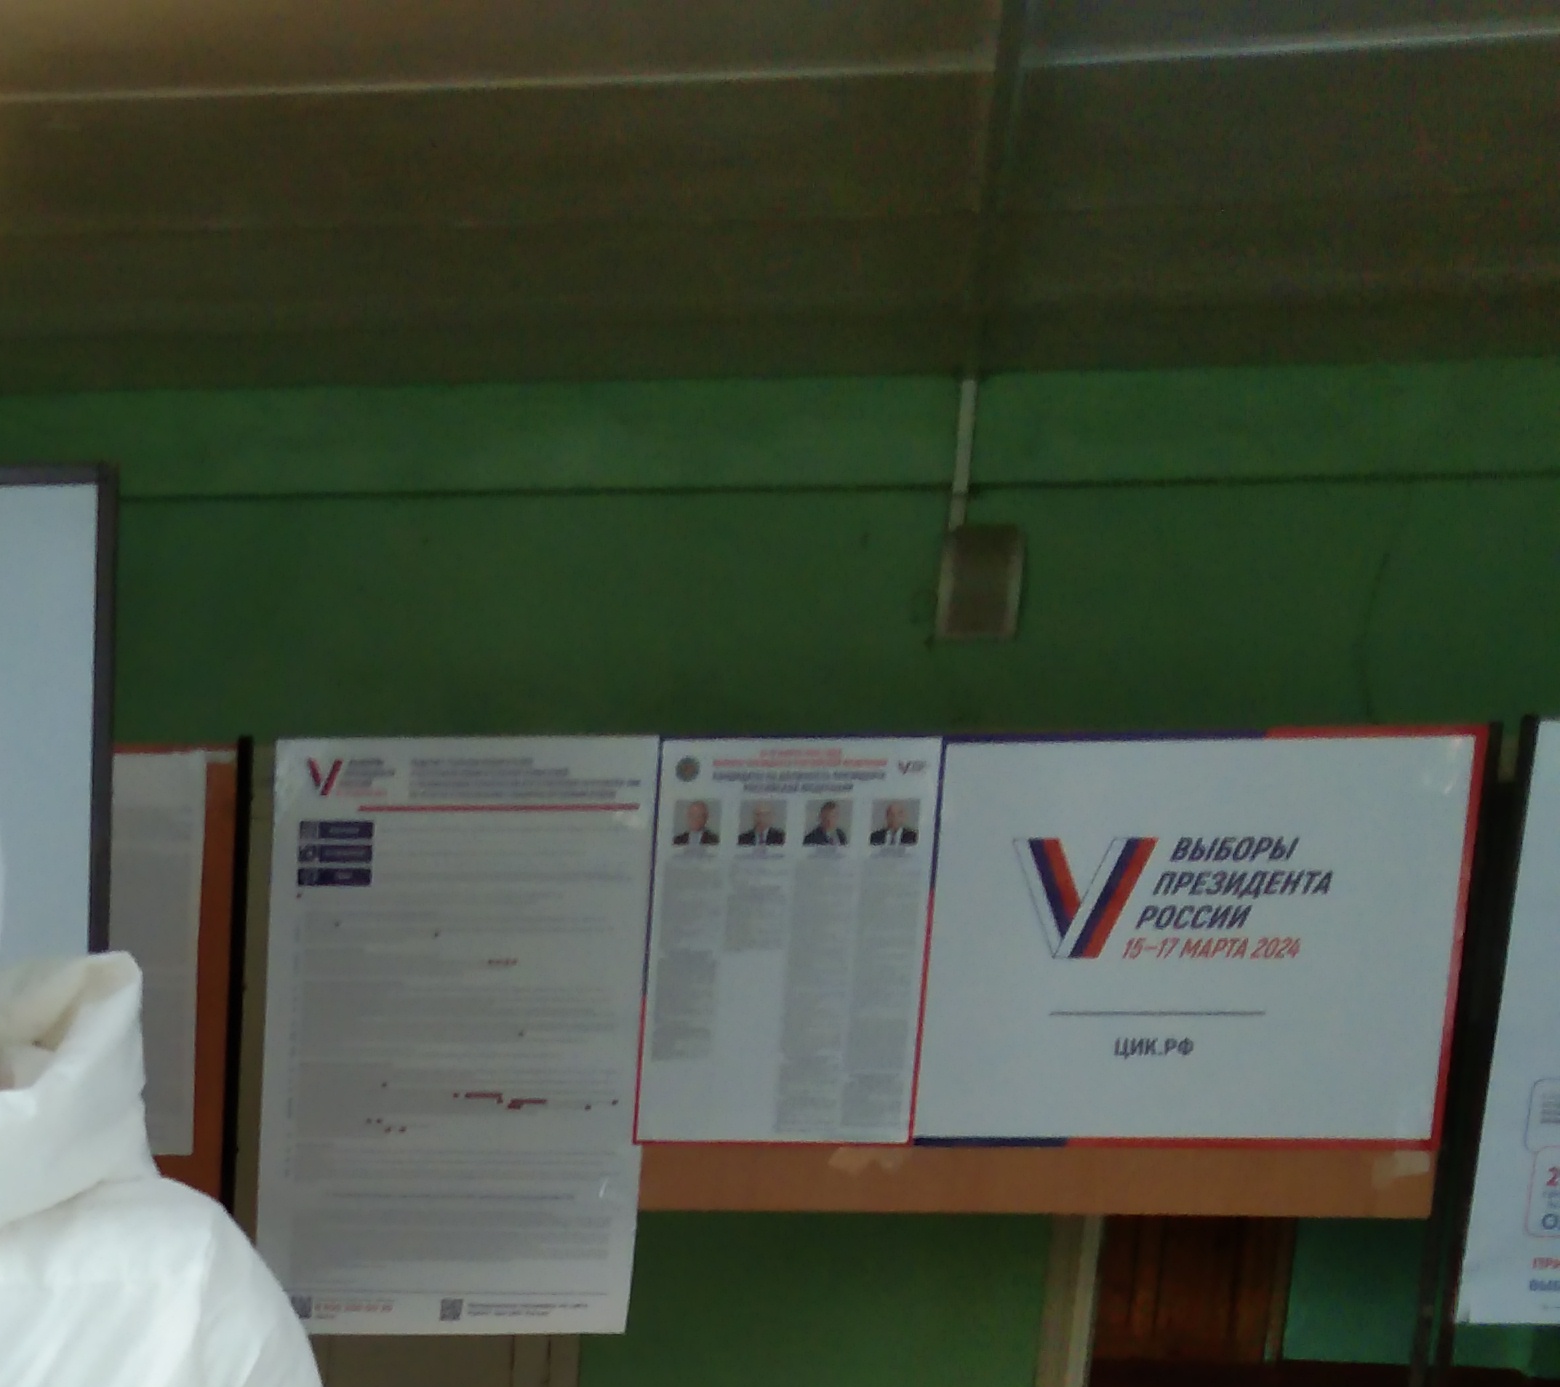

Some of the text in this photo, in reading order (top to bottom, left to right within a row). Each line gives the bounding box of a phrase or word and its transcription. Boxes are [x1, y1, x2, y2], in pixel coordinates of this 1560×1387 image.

[1170, 836, 1300, 862] ВЫБОРЫ
[1152, 870, 1334, 899] ПРЕЗИДЕНТА
[1135, 904, 1252, 930] РОССИИ
[1178, 937, 1250, 959] МАРТА
[1250, 937, 1301, 960] 2024
[1113, 1037, 1195, 1059] ЦИК.РФ
